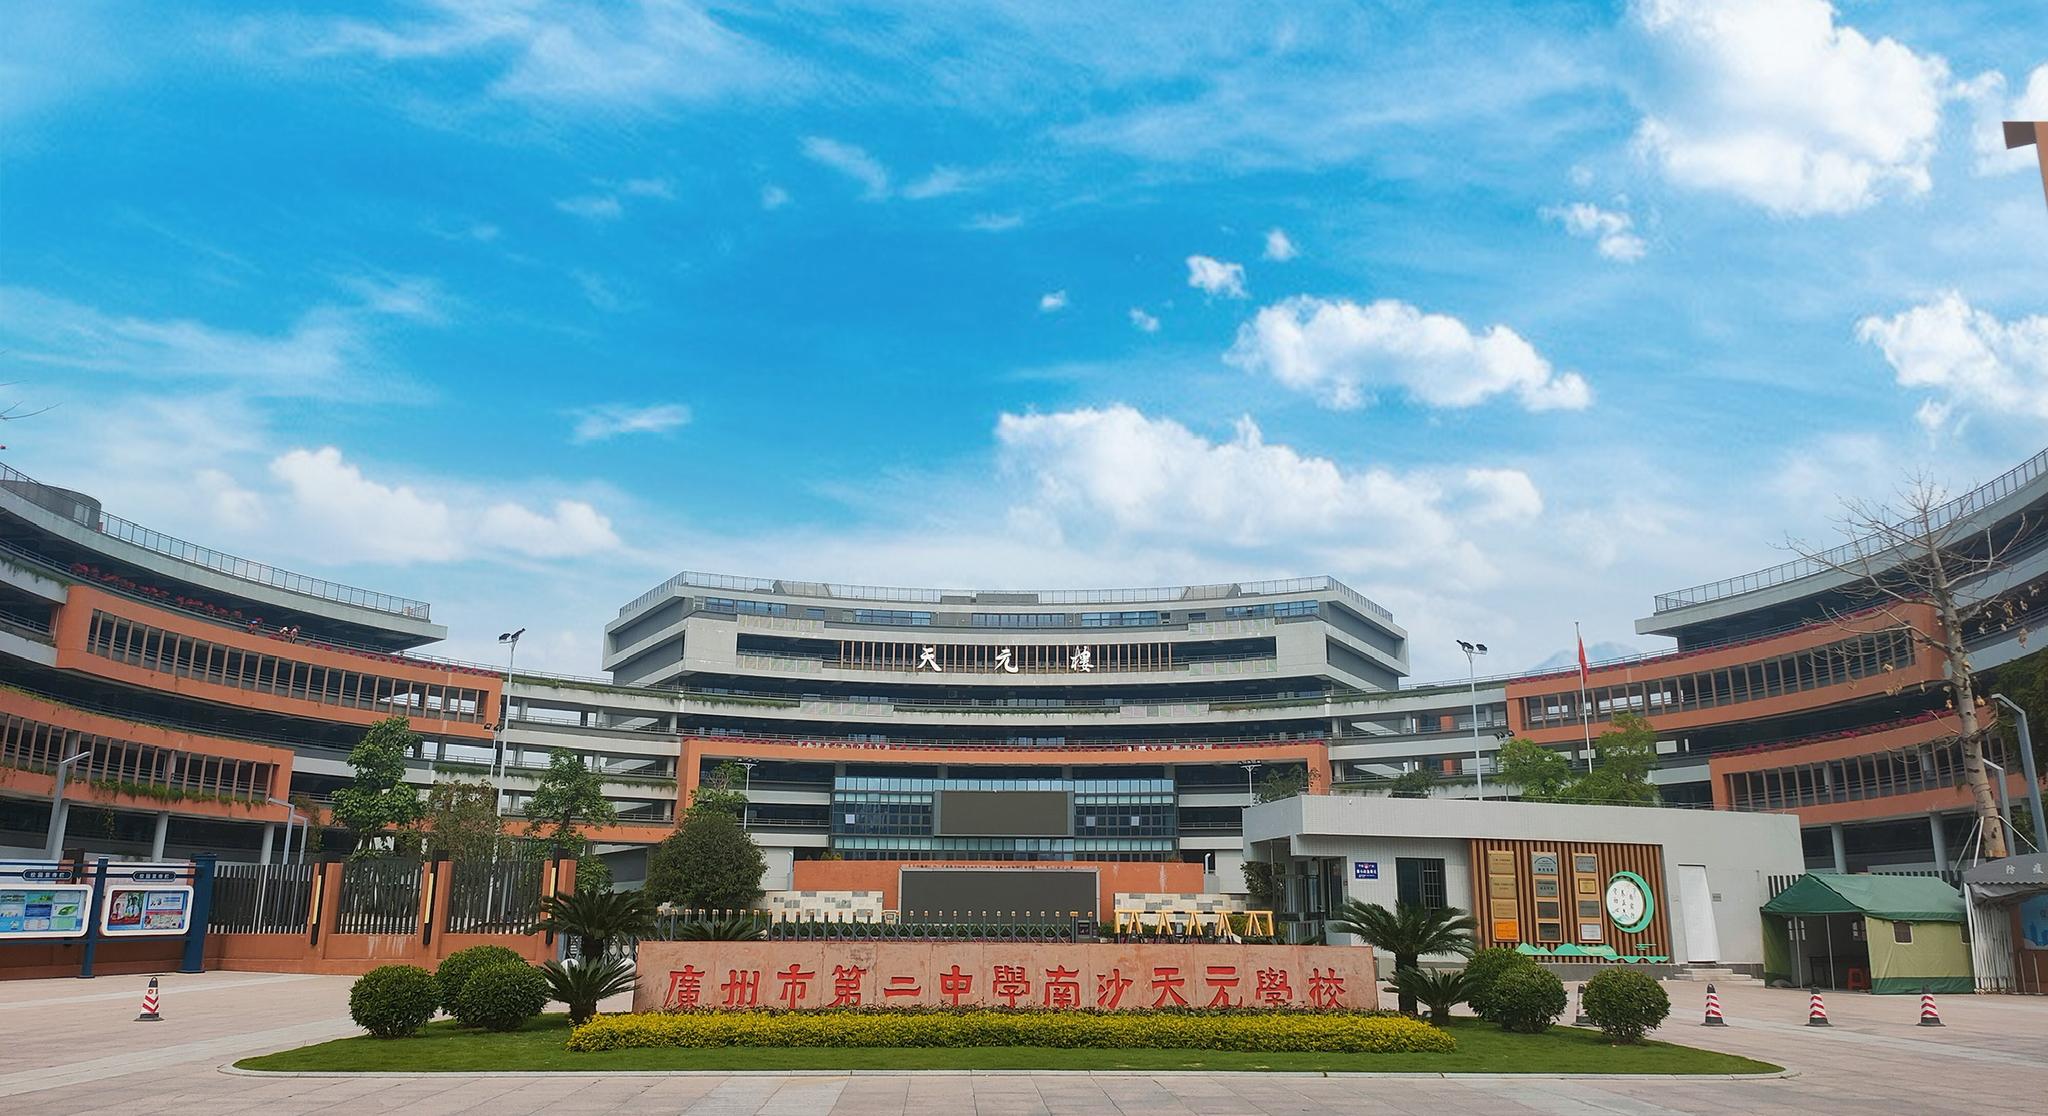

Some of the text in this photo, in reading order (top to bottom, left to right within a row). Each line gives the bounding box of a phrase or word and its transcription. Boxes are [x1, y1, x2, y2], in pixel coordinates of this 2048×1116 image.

[663, 964, 1346, 1008] 廣州市第二中學南沙天元學校
